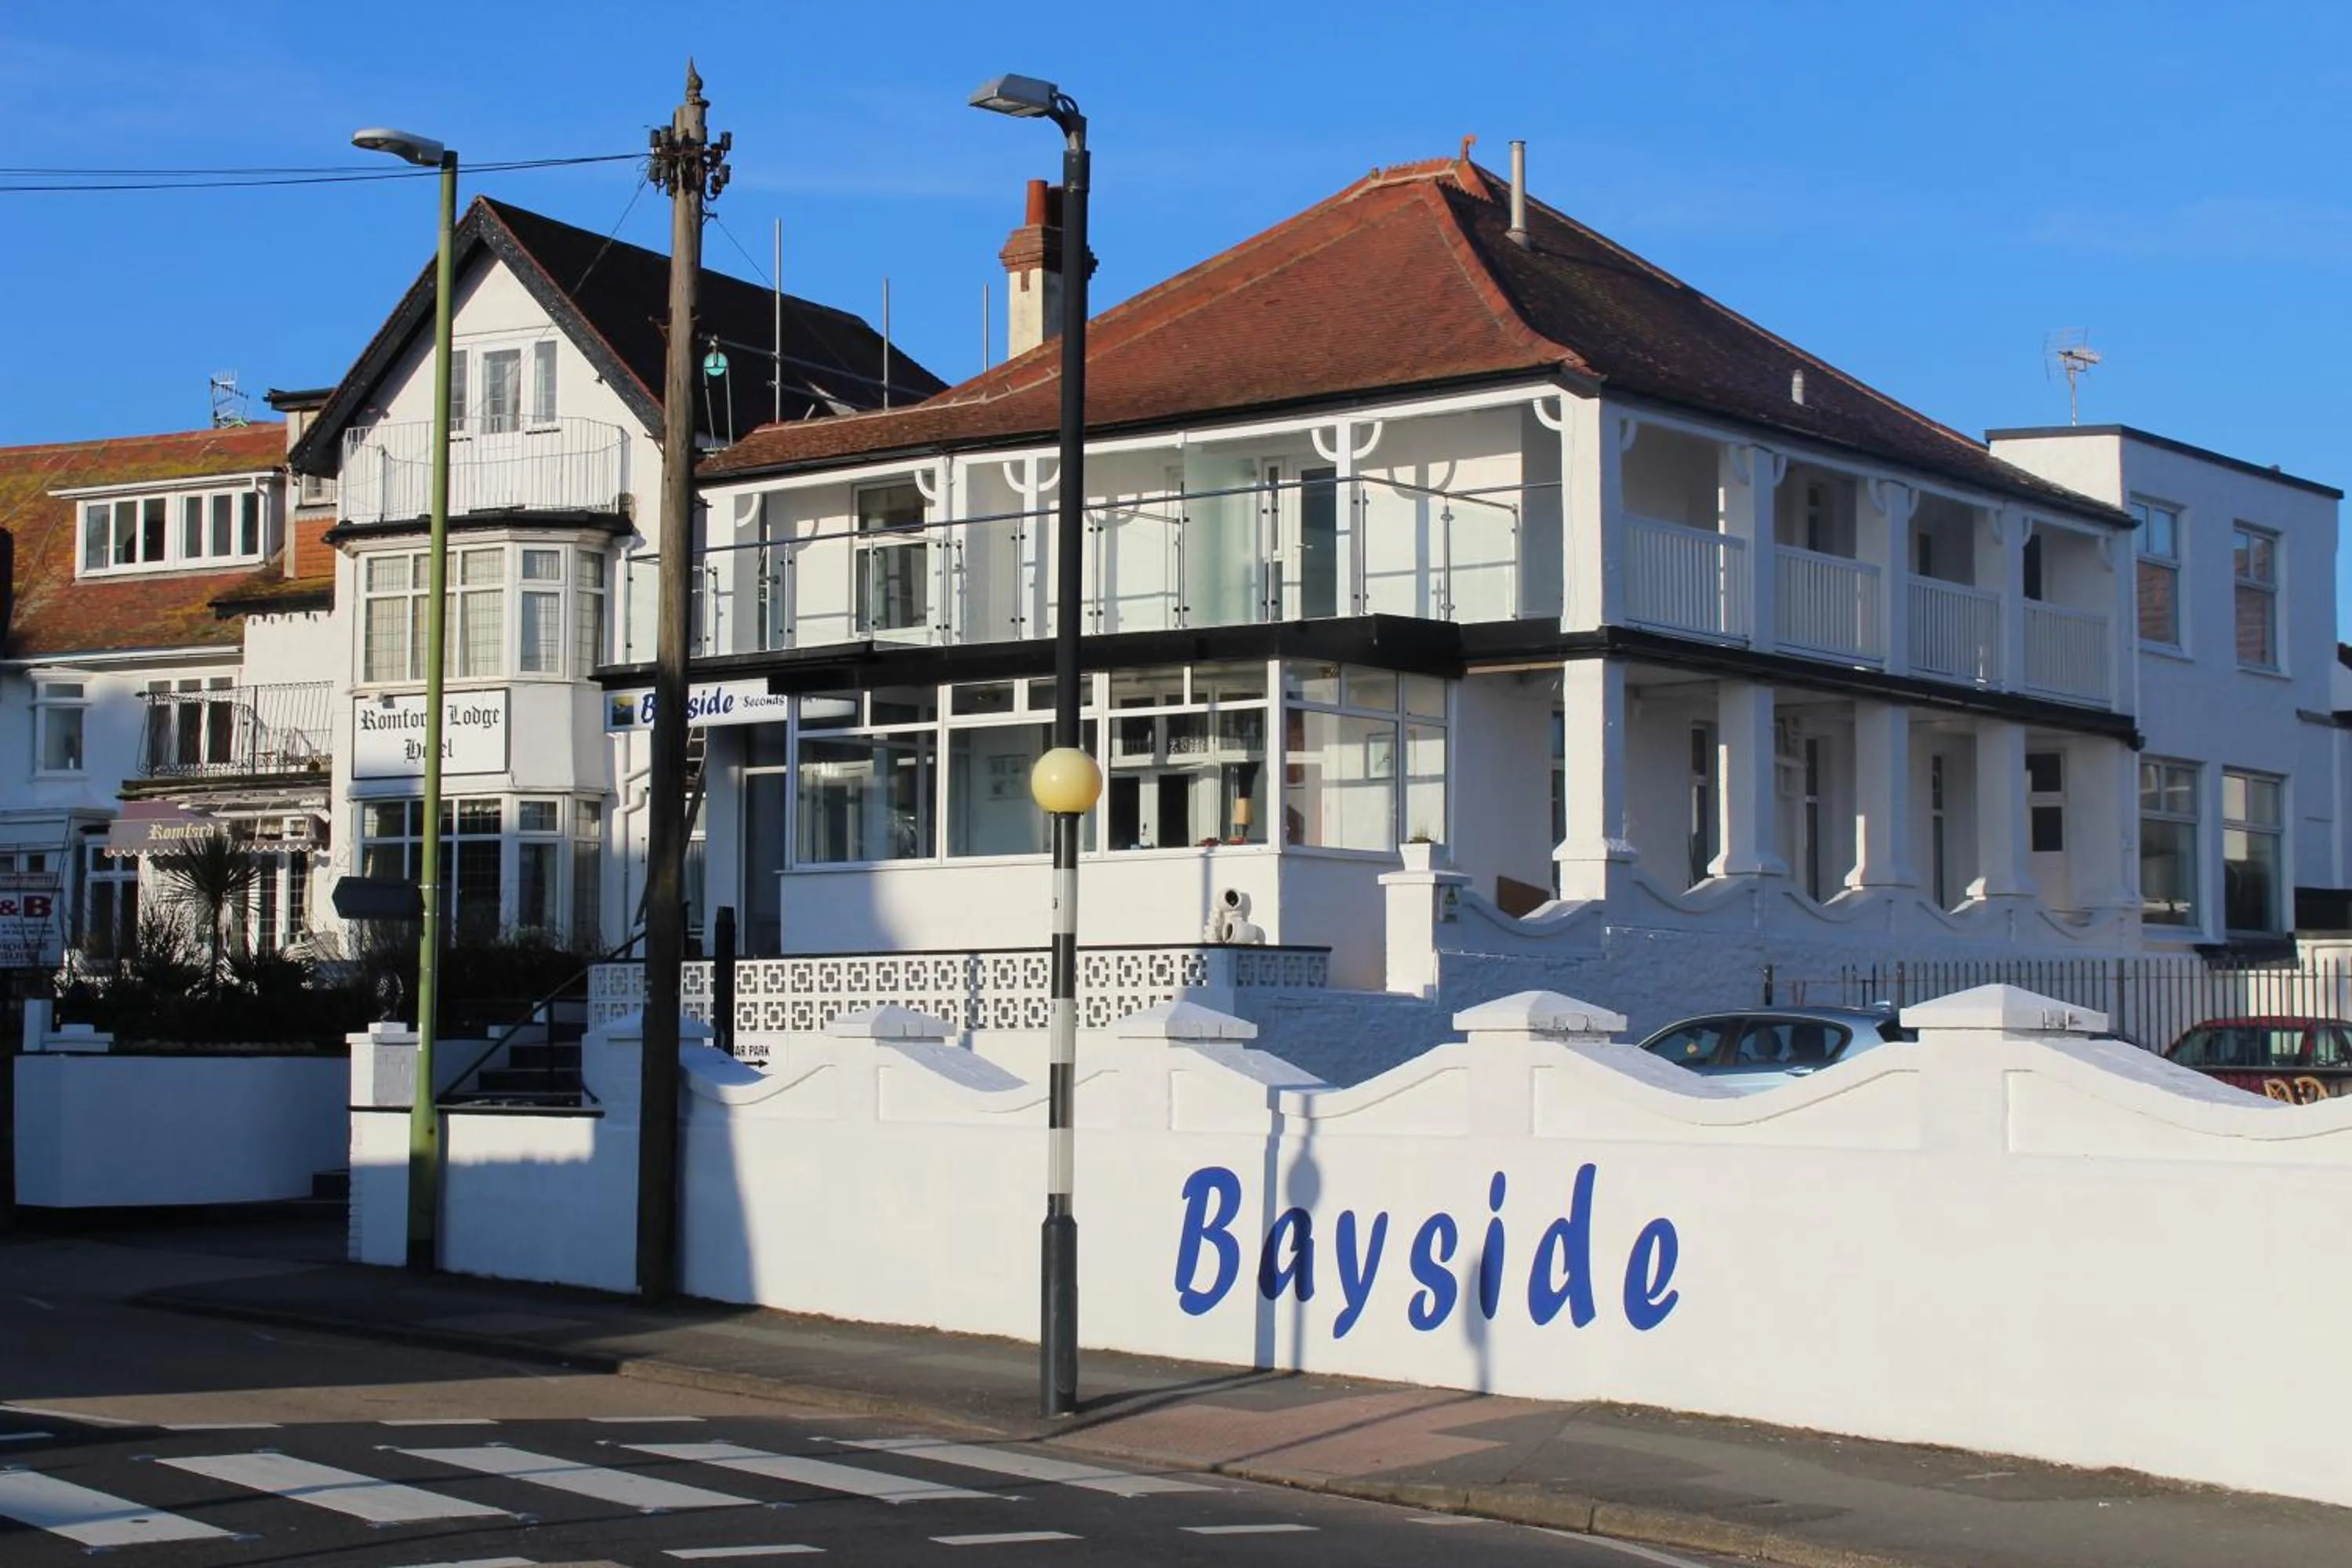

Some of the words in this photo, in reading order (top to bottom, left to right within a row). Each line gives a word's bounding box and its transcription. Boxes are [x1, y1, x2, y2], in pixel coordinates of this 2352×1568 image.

[361, 707, 427, 730] Romfor
[448, 705, 499, 728] Lodge
[641, 687, 734, 723] Bside
[405, 738, 453, 764] Hel
[734, 1045, 746, 1056] AR
[749, 1045, 770, 1057] PARK
[1174, 1163, 1679, 1339] Bayside
